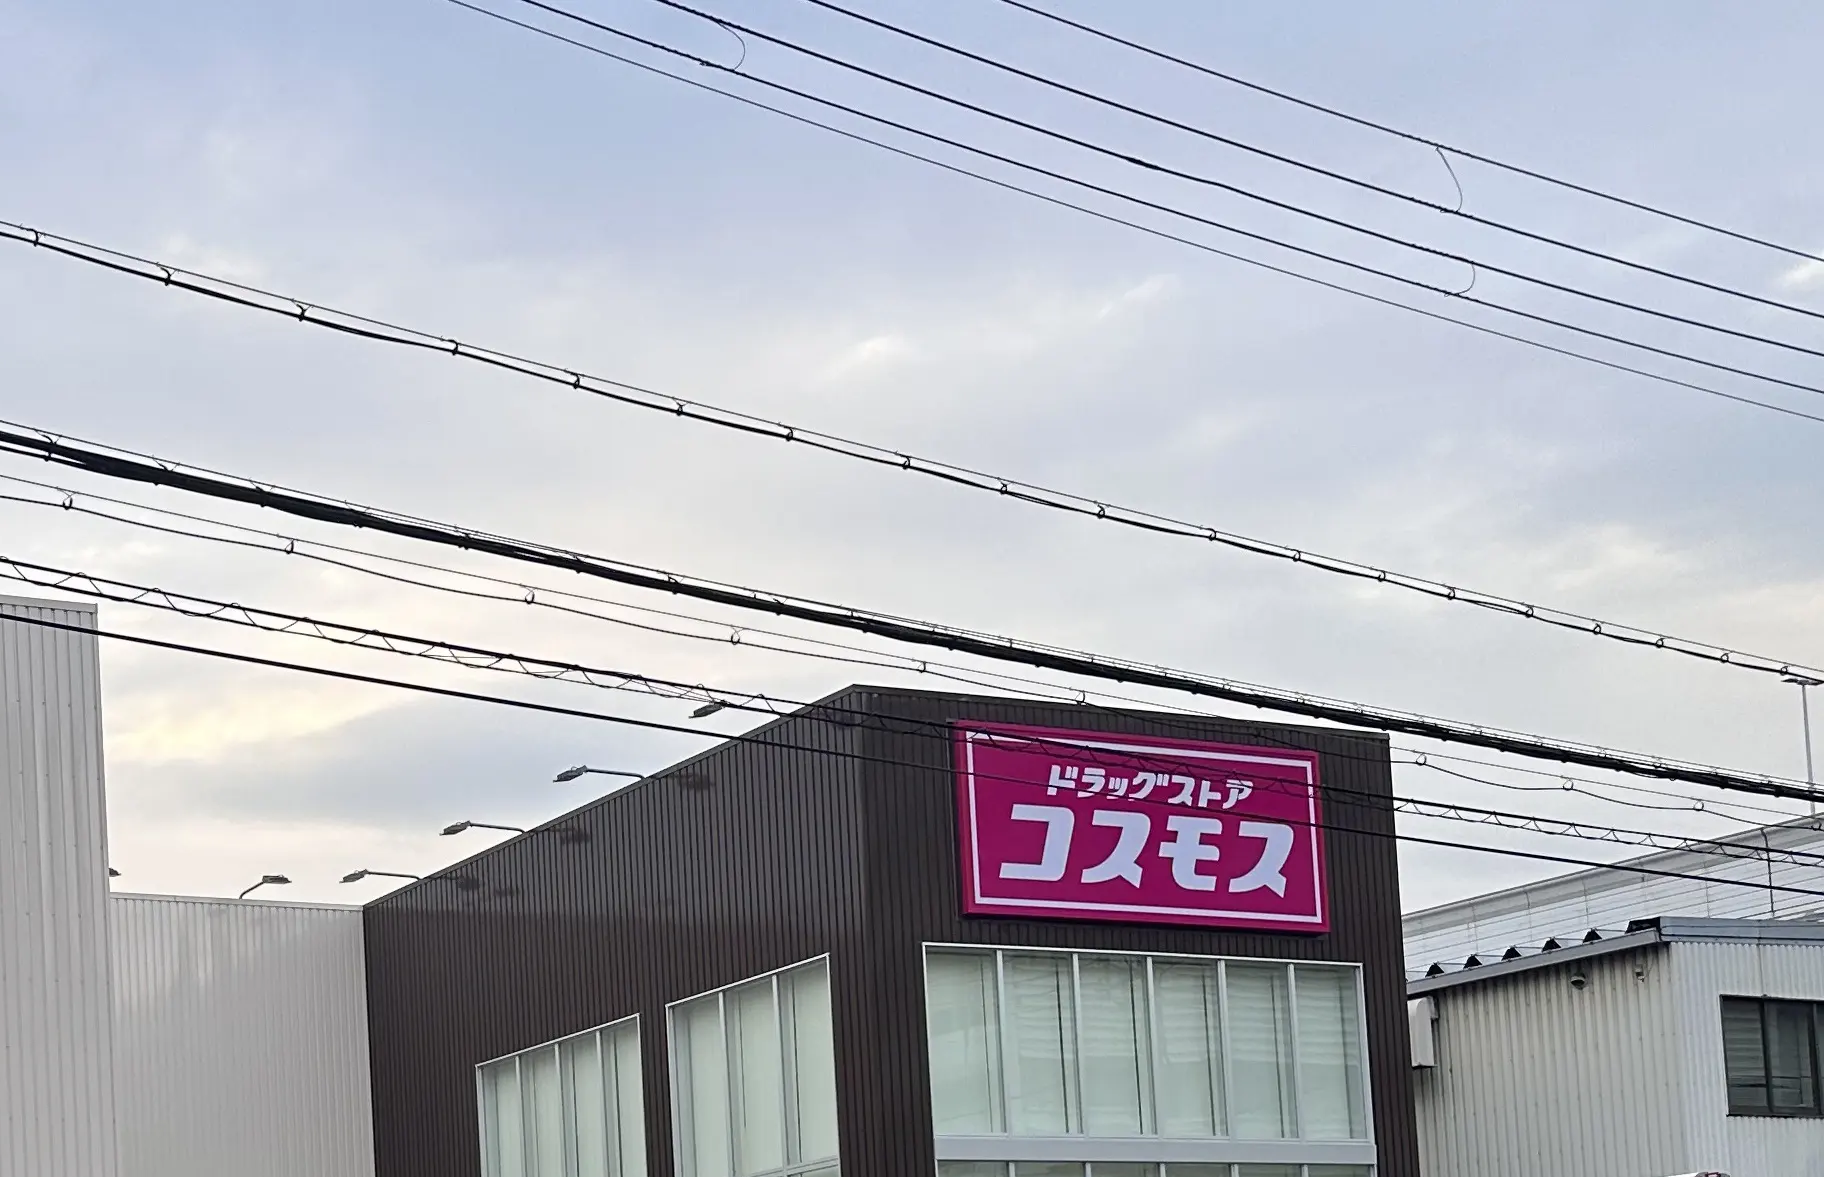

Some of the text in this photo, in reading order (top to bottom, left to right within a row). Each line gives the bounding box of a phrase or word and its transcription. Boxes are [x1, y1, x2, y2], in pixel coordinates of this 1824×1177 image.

[1047, 764, 1253, 809] ドラッグストア
[998, 803, 1294, 899] コスモス
